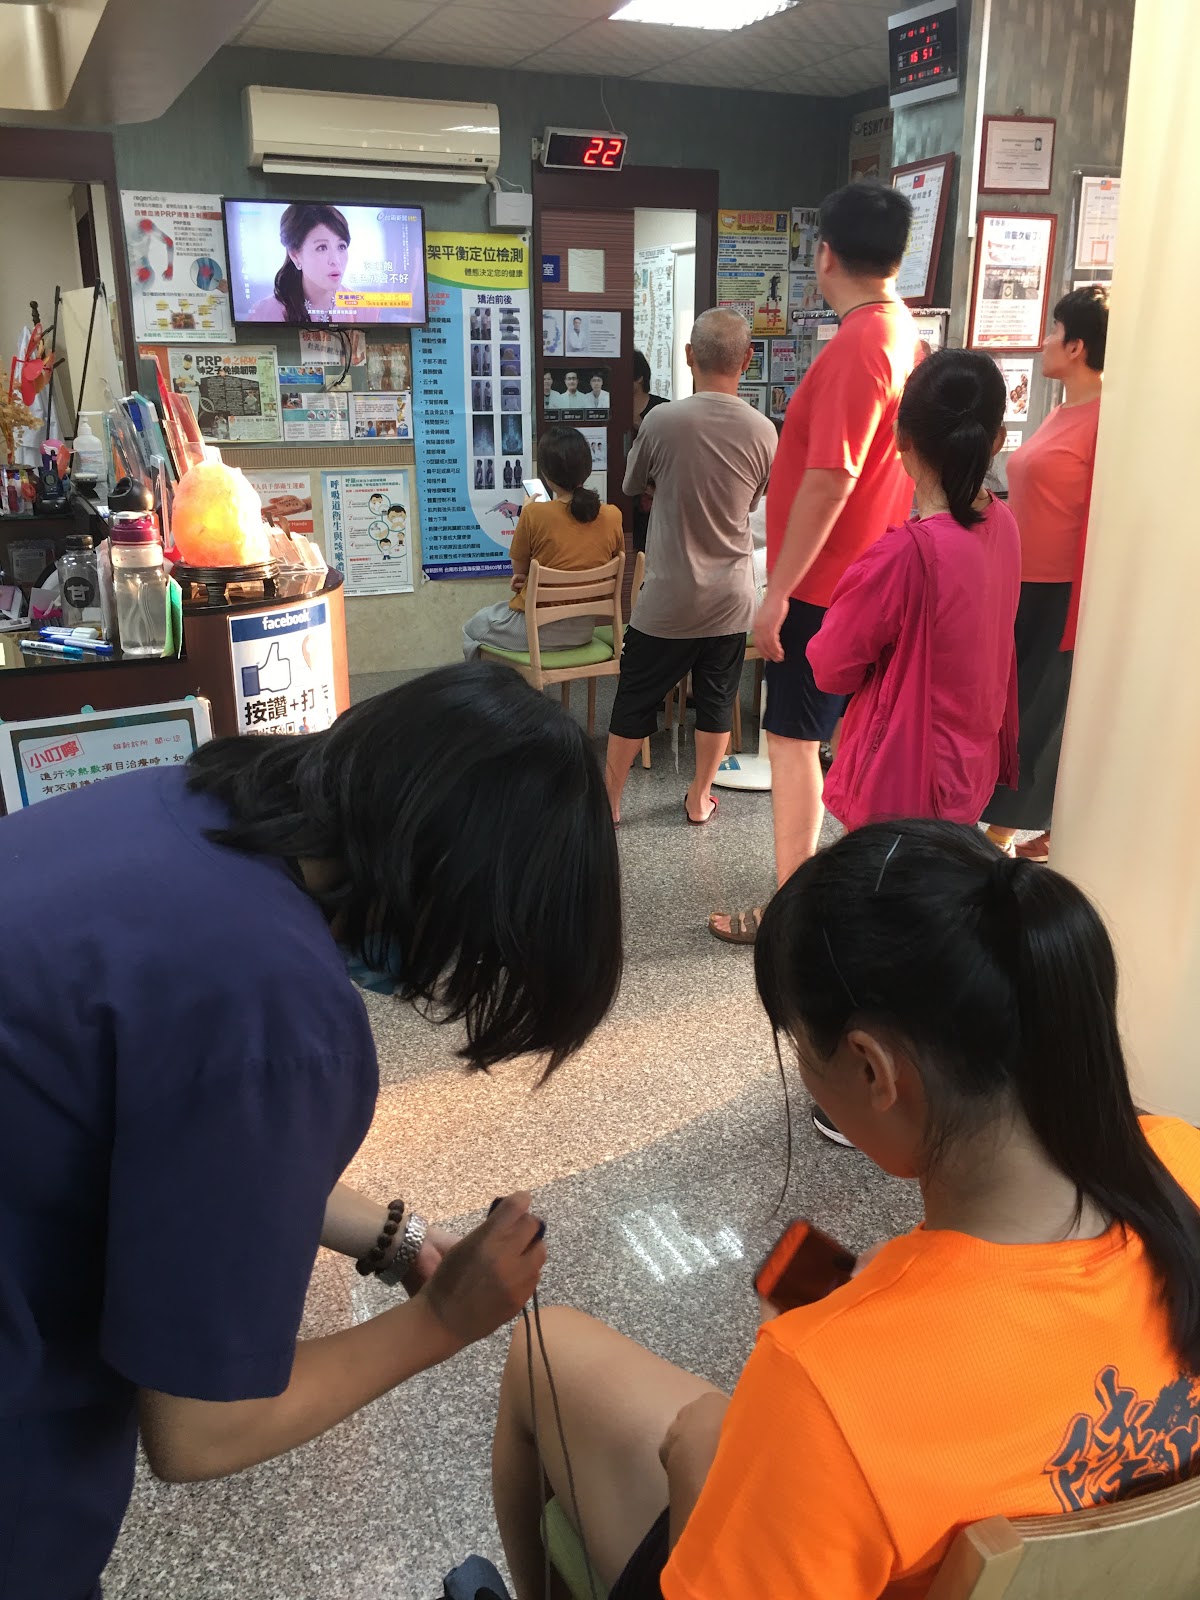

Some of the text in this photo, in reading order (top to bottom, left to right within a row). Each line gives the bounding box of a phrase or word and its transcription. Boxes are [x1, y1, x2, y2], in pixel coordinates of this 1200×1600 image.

[584, 138, 622, 165] 22
[427, 245, 524, 263] 架平衡定位檢測
[465, 268, 523, 278] 體態決定您的健康
[478, 294, 512, 305] 矯治前後
[67, 584, 89, 600] 甘
[262, 610, 311, 630] facebook
[30, 740, 79, 768] 小叮嚀
